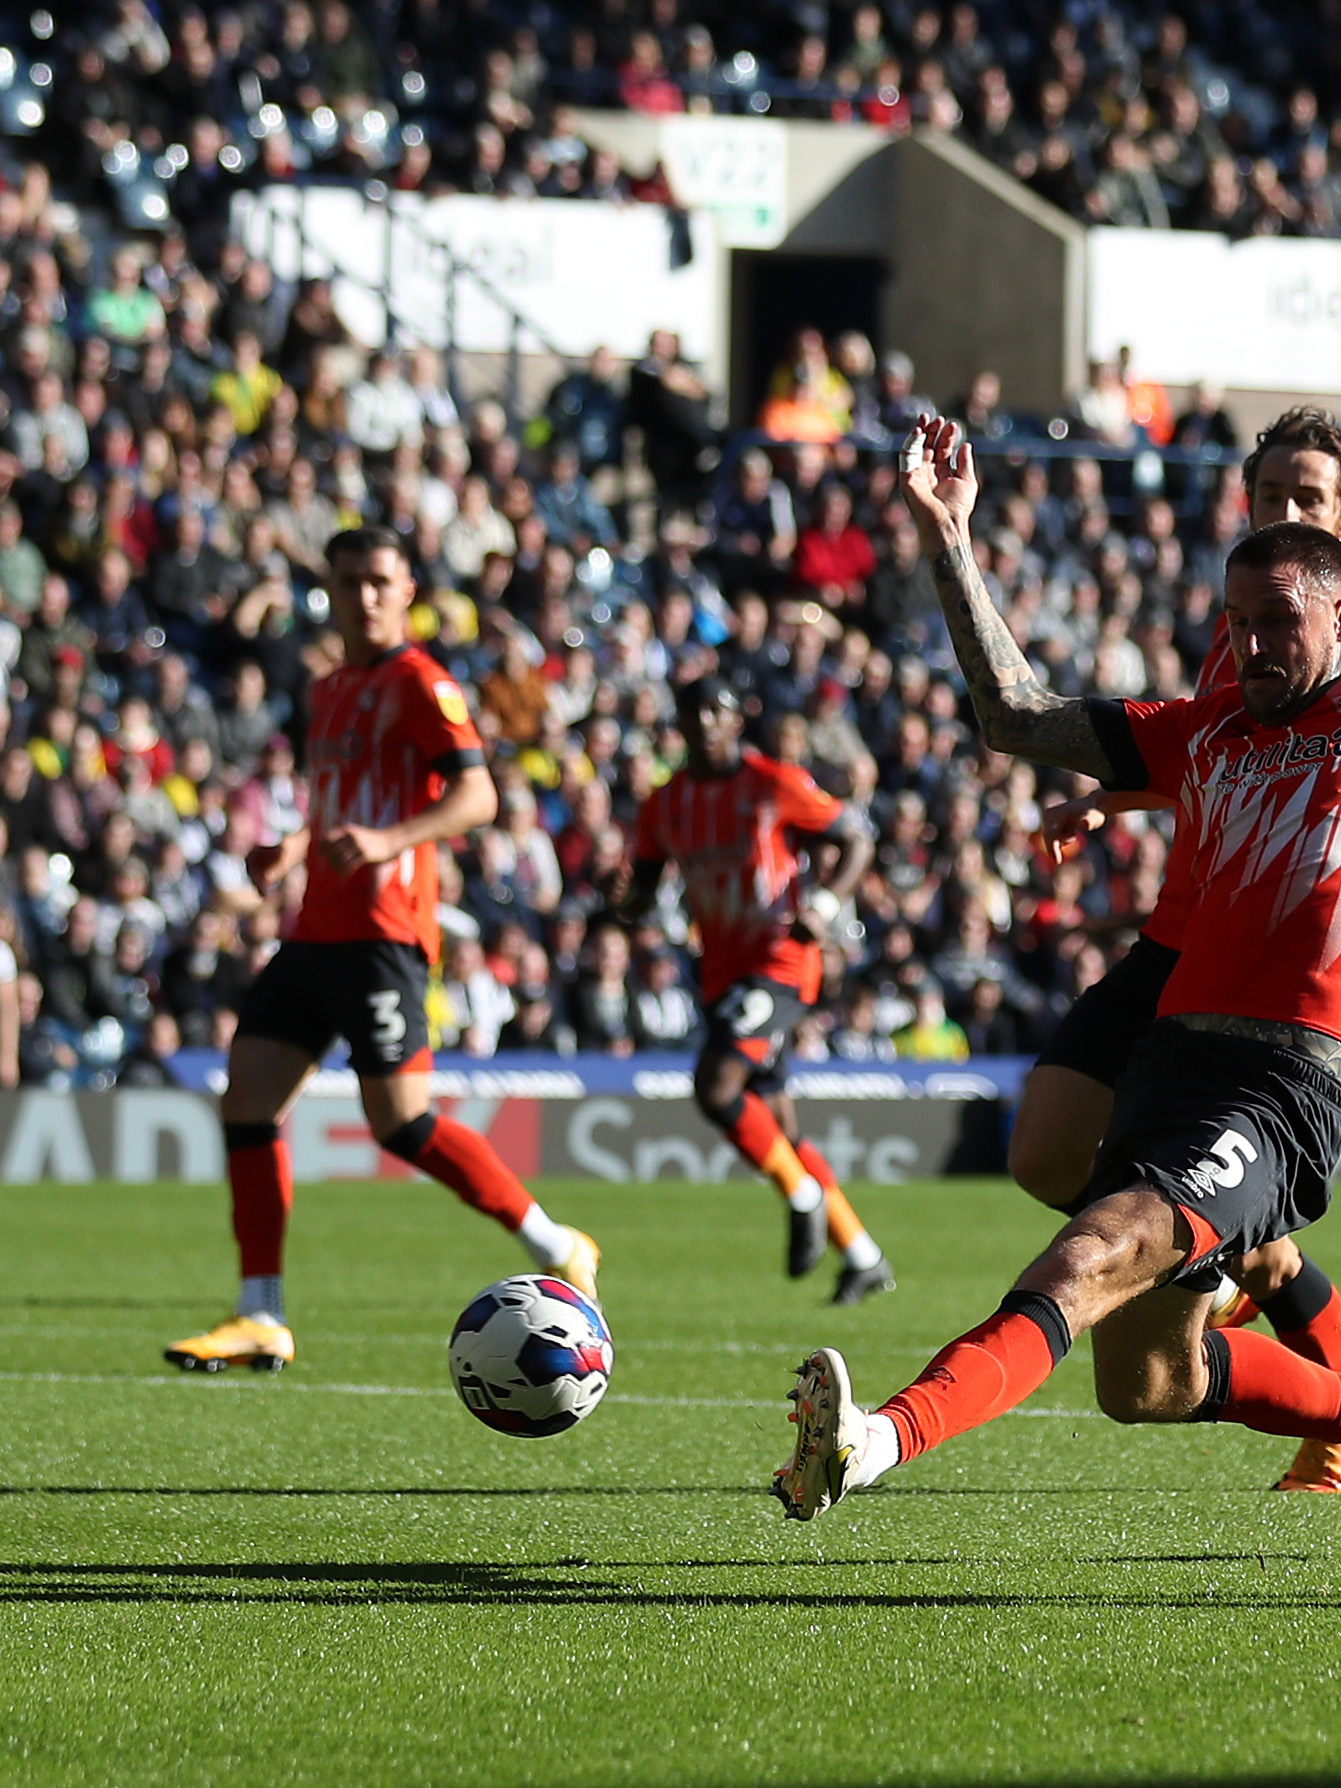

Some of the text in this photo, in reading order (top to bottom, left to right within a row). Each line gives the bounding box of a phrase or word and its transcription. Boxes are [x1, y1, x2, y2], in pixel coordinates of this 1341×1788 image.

[676, 136, 774, 187] V22
[1220, 735, 1329, 783] utilita
[367, 988, 407, 1044] 3
[1196, 1129, 1258, 1189] 5
